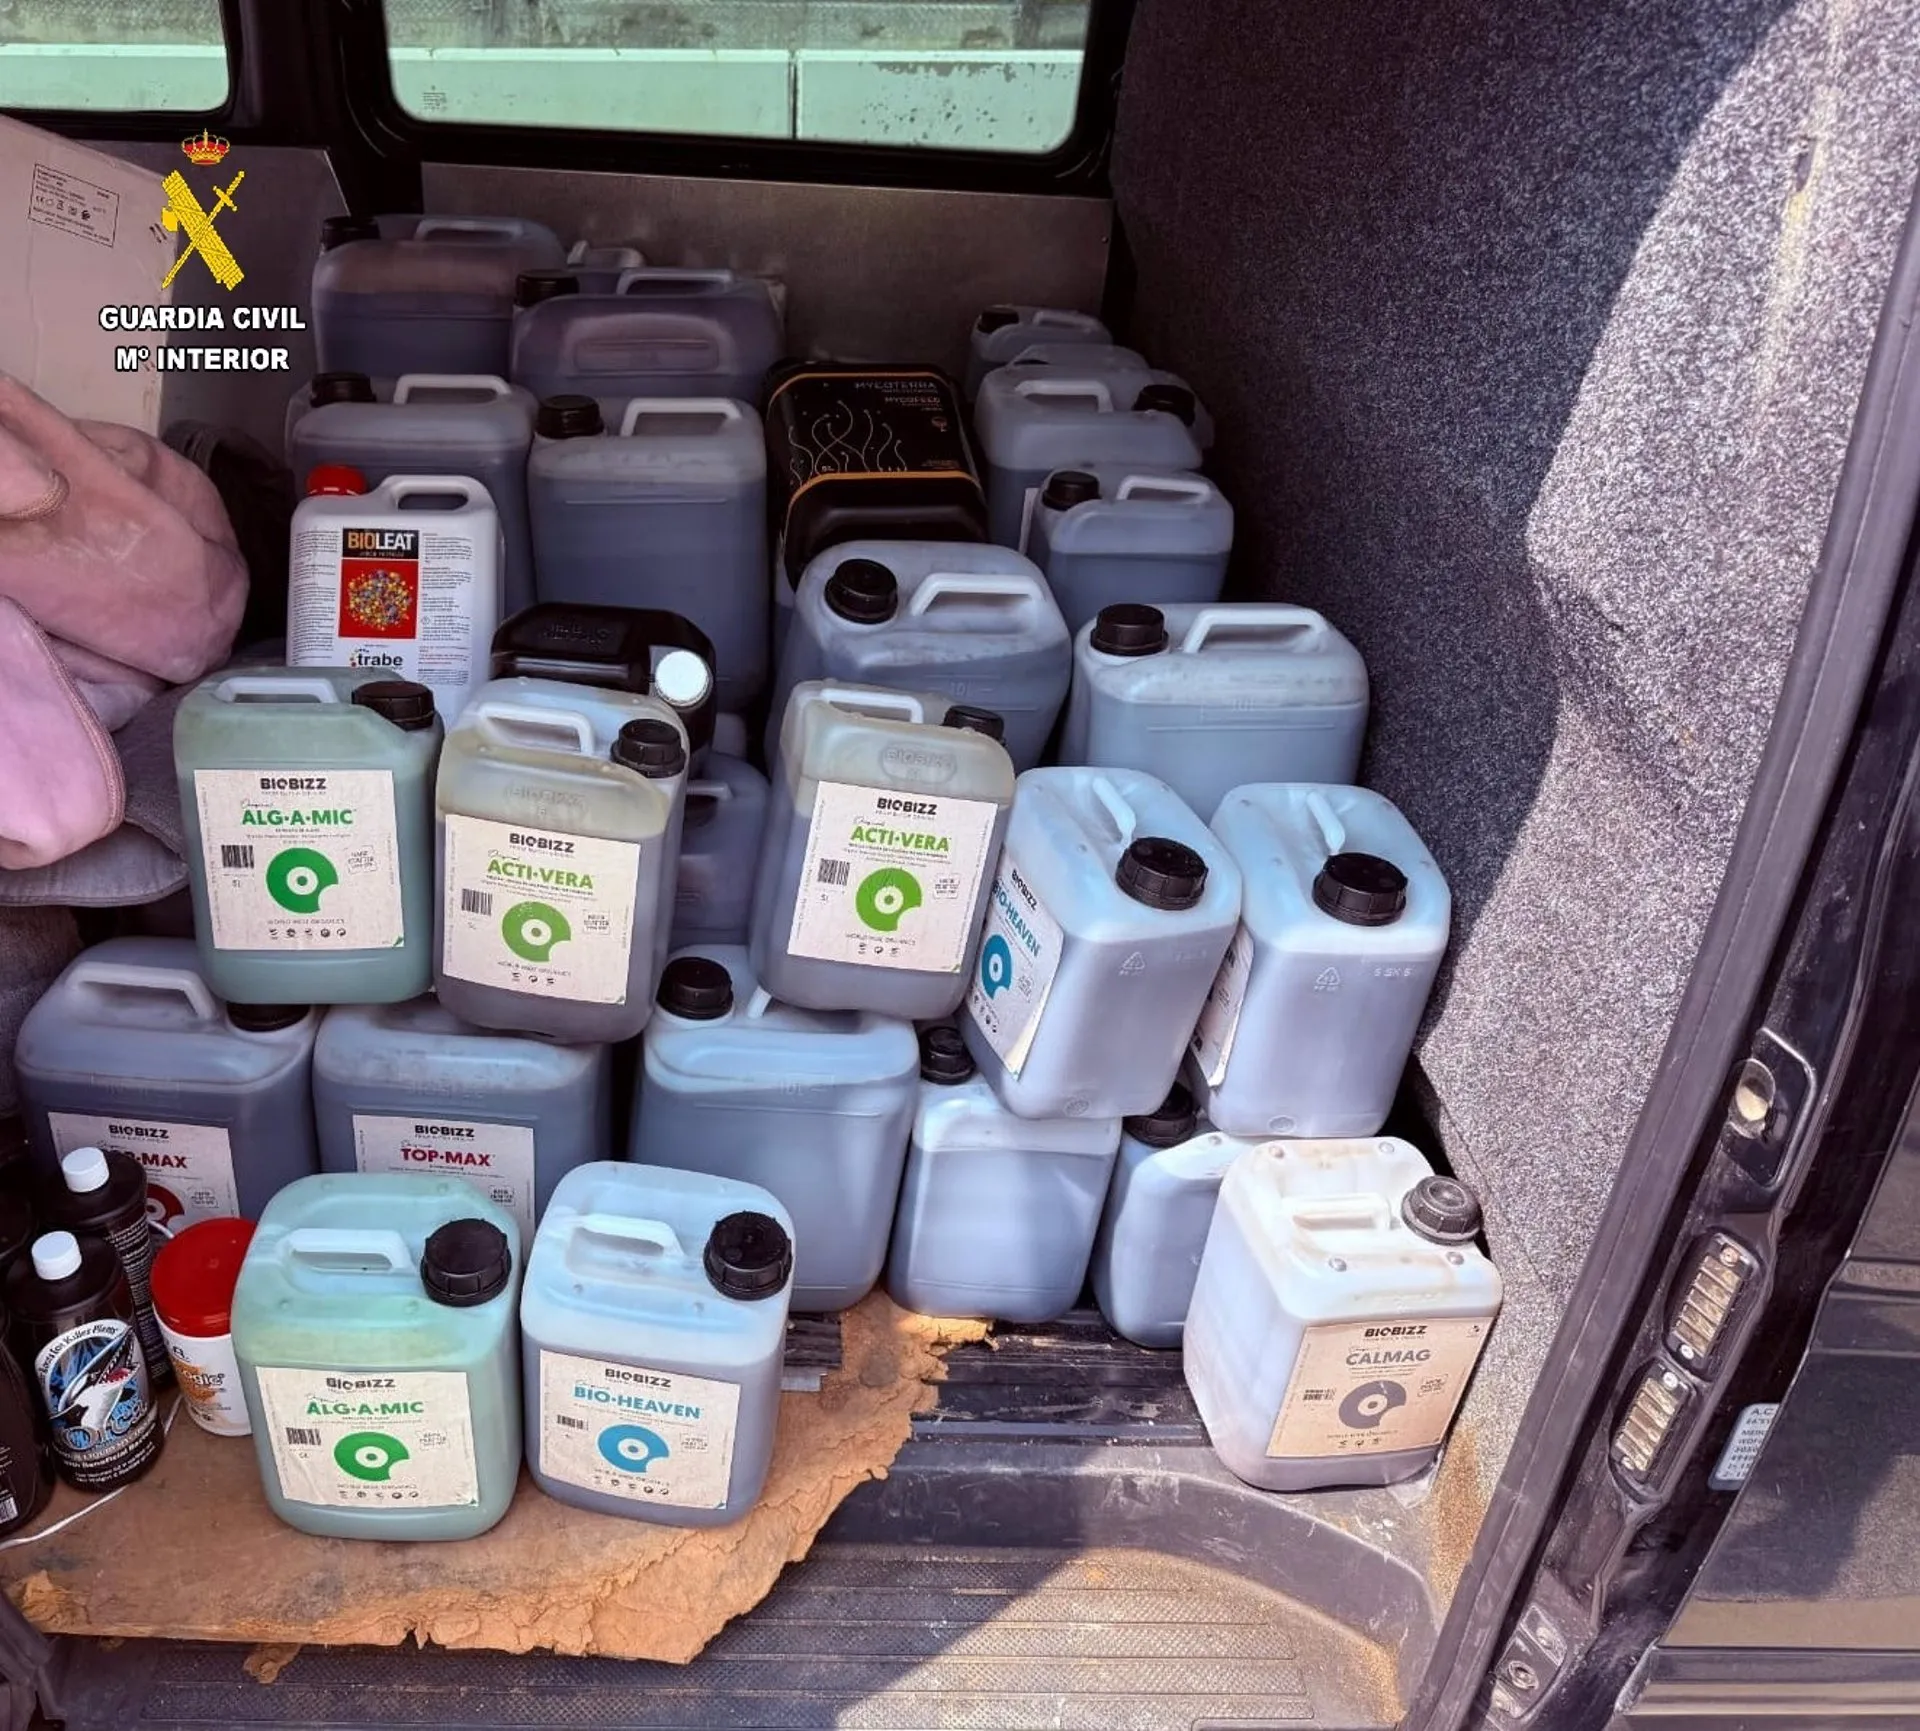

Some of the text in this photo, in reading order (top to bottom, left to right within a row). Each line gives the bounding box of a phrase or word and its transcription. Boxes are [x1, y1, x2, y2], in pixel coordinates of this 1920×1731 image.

[347, 532, 416, 551] BIOLEAT
[356, 653, 404, 667] trabe
[260, 777, 327, 790] BIOBIZZ
[876, 797, 938, 816] BIOBIZZ
[508, 833, 575, 854] BIOBIZZ
[1011, 868, 1038, 912] BIOBIZZ
[108, 1124, 170, 1139] BIOBIZZ
[414, 1124, 475, 1138] BIOBIZZ
[1364, 1325, 1428, 1338] BIOBIZZ
[1345, 1348, 1431, 1366] CALMAG
[326, 1377, 396, 1391] BIOBIZZ
[604, 1368, 672, 1388] BIOBIZZ
